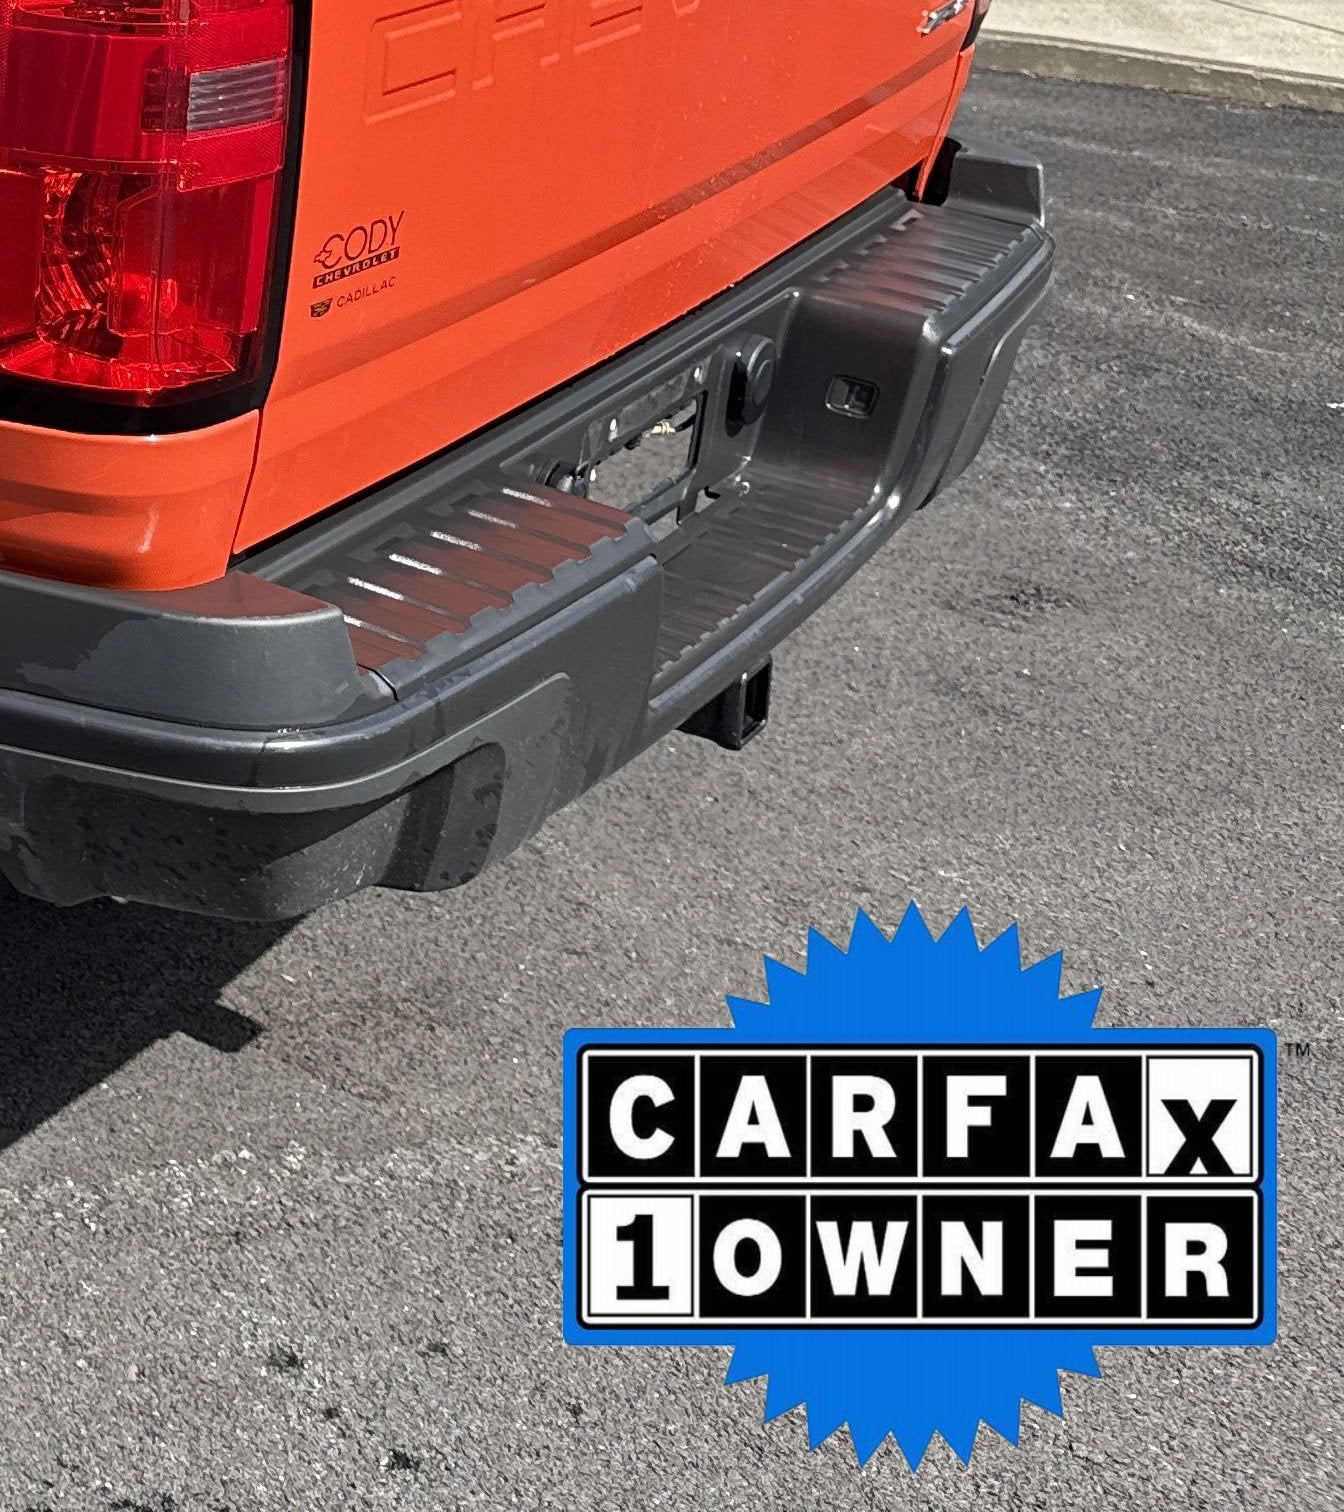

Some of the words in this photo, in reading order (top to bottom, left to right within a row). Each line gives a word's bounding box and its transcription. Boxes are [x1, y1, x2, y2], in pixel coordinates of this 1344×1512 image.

[316, 209, 405, 269] CODY
[316, 248, 398, 286] CHEVROLET
[336, 276, 397, 308] CADILLAC
